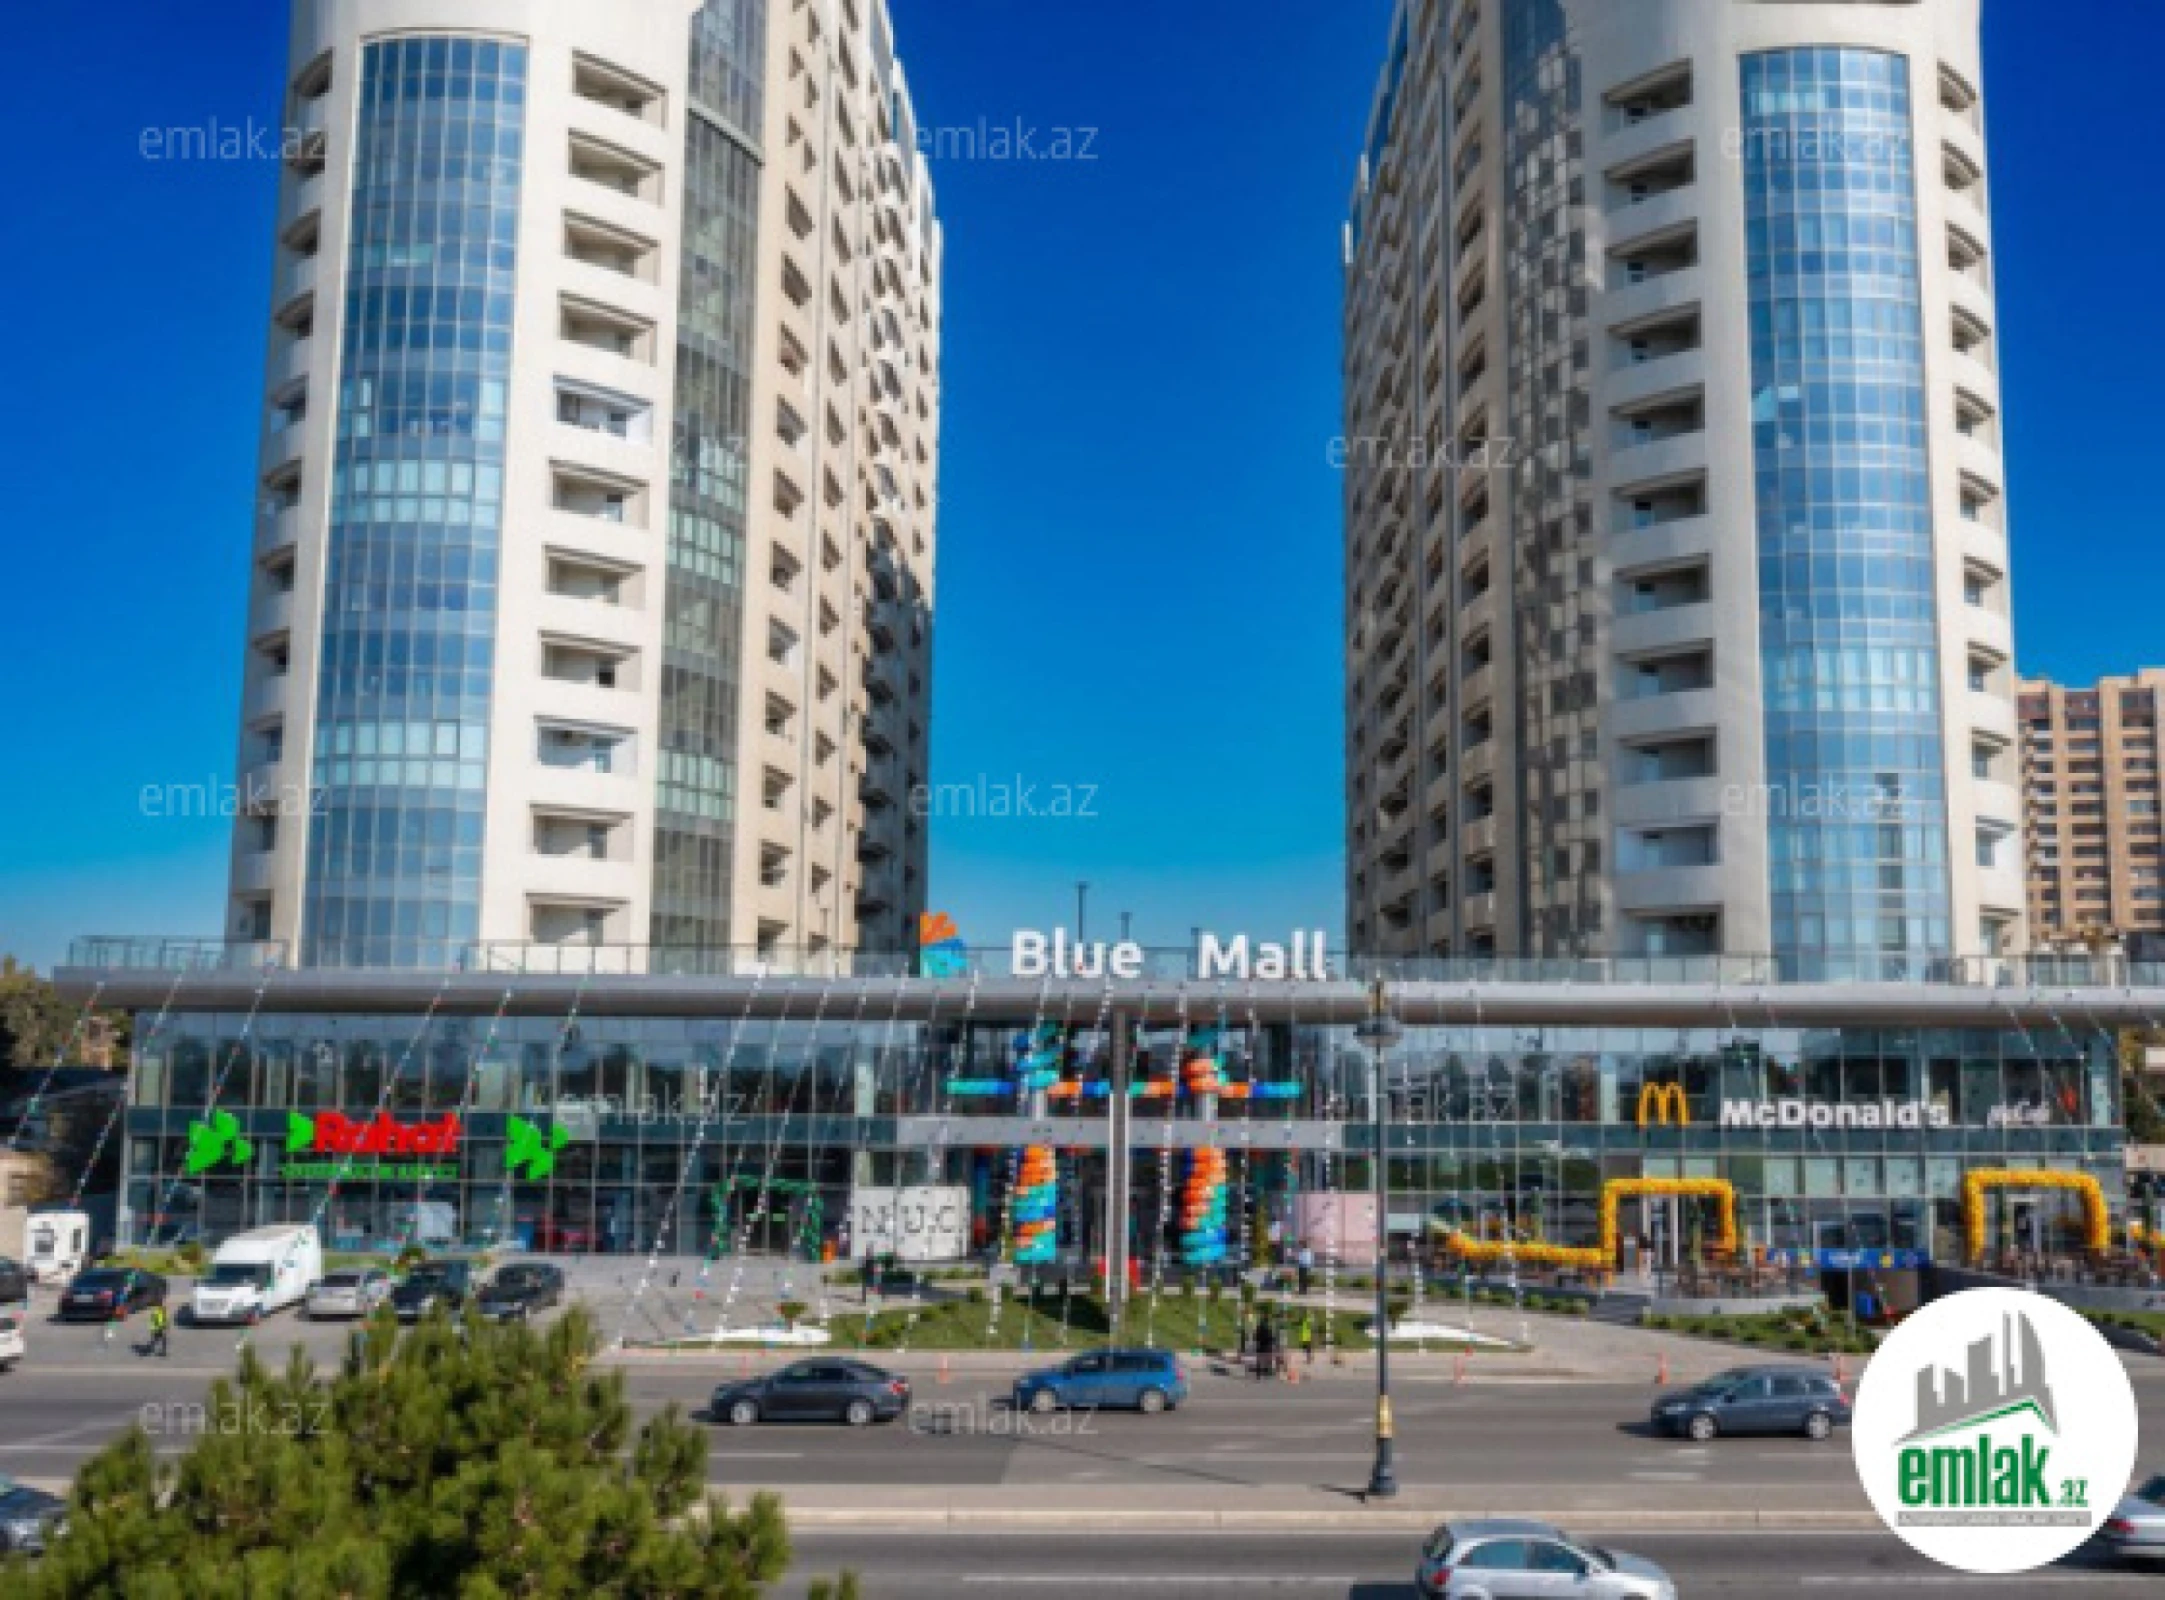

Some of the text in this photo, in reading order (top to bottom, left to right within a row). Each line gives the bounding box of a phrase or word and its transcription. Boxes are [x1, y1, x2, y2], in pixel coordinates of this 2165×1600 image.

[1012, 927, 1328, 981] Blue Mall
[1720, 1098, 1950, 1126] McDonald's
